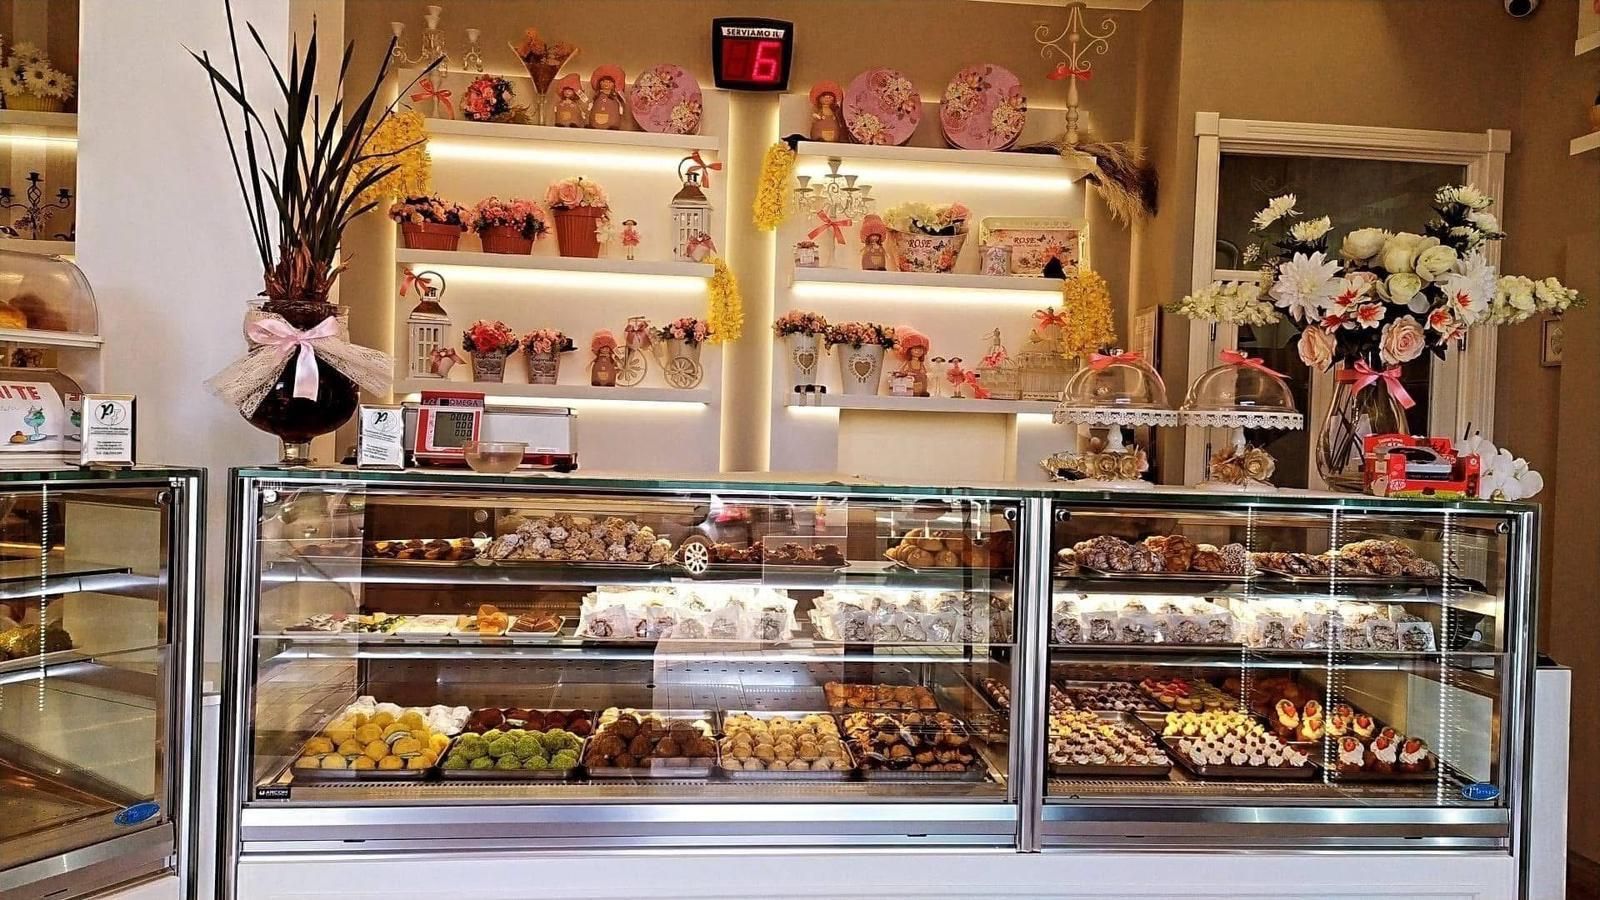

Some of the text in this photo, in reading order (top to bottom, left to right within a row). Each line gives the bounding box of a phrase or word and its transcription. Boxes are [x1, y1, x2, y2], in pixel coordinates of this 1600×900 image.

[726, 28, 771, 37] SERVIAMO
[752, 41, 780, 81] 6
[908, 239, 932, 249] ROSE
[449, 399, 478, 407] OMEGA
